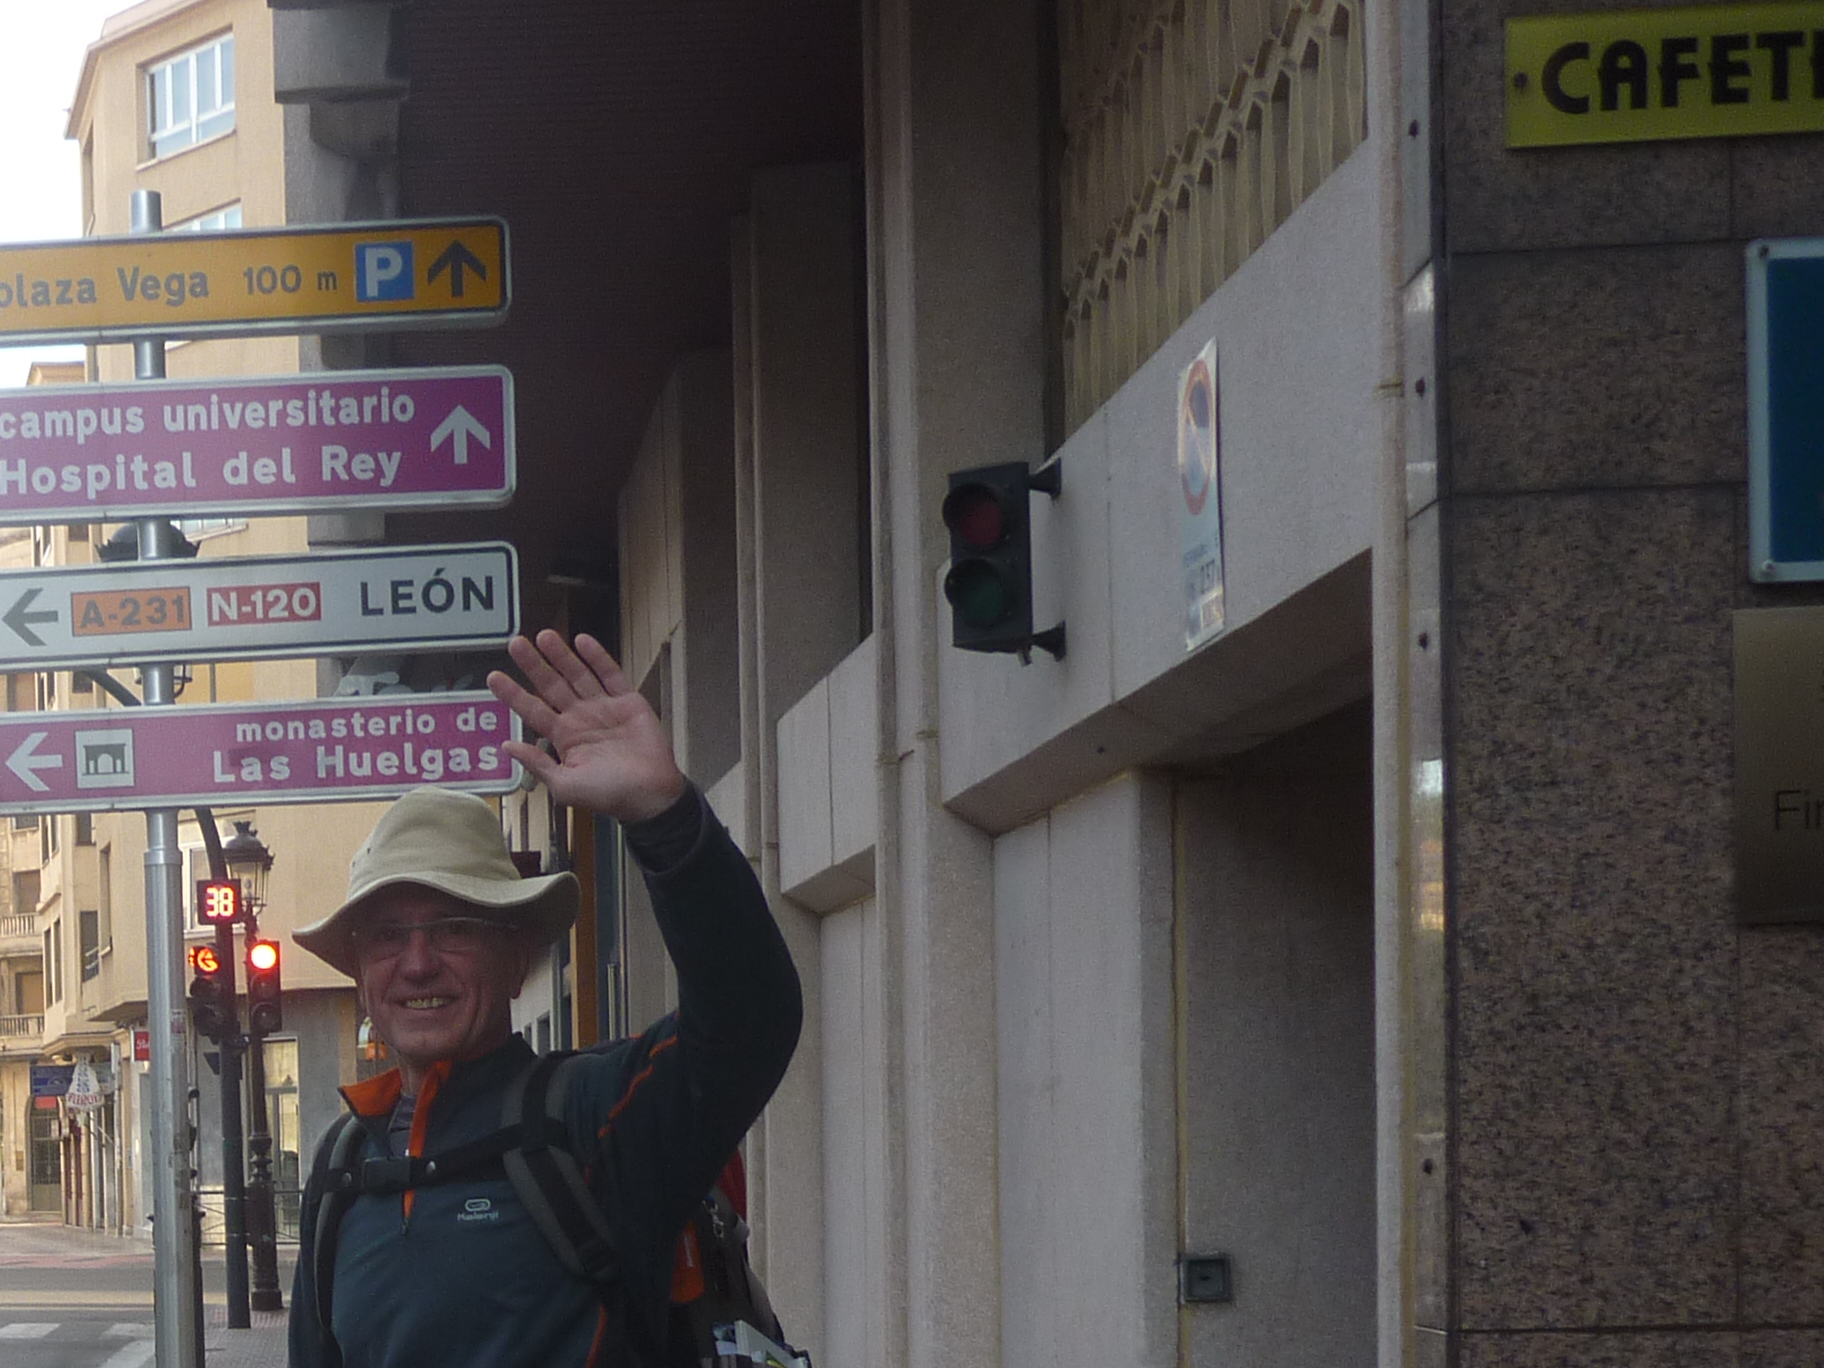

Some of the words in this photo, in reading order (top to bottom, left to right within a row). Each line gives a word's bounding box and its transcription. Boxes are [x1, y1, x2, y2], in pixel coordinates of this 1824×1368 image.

[116, 264, 209, 307] Vega
[243, 264, 302, 295] 100
[316, 271, 338, 293] m
[363, 248, 404, 298] P
[163, 386, 415, 433] universitario
[222, 446, 296, 486] del
[321, 445, 403, 487] Rey
[78, 593, 187, 630] A-231
[210, 586, 318, 622] N-120
[359, 568, 495, 618] LEÓN
[235, 707, 436, 744] monasterio
[455, 706, 499, 733] de
[213, 749, 292, 785] Las
[315, 744, 500, 782] Huelgas
[206, 887, 234, 917] 38
